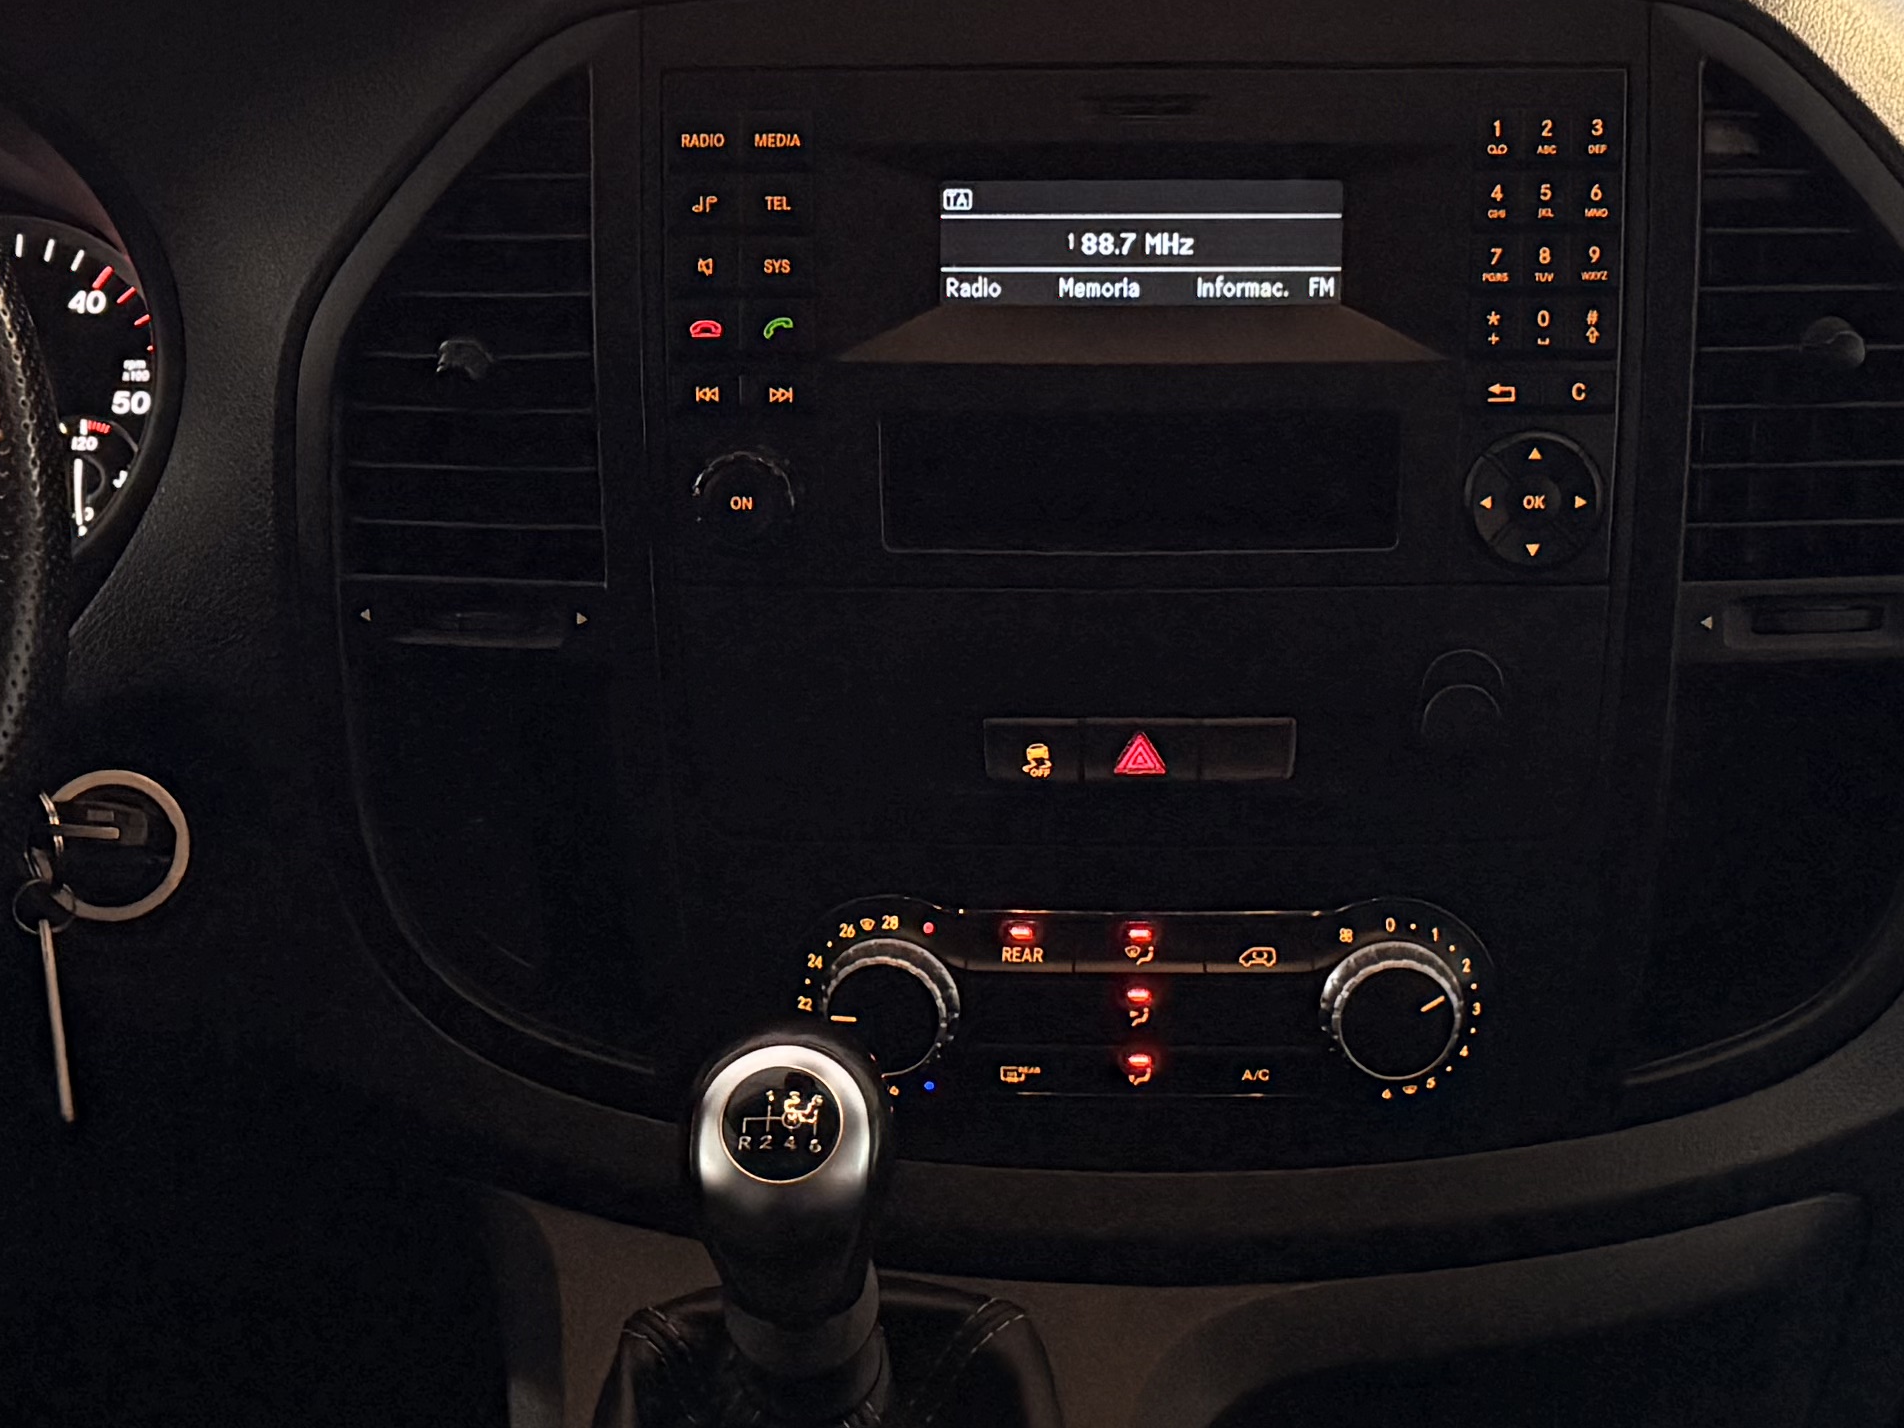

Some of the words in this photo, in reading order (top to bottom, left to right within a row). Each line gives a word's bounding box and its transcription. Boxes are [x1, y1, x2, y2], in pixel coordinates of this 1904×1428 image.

[1493, 119, 1501, 138] 1
[1541, 119, 1553, 137] 2
[1591, 118, 1604, 137] 3
[681, 133, 725, 148] RADIO
[754, 132, 801, 148] MEDIA
[1536, 144, 1557, 155] ABC
[946, 193, 969, 208] TA
[1490, 184, 1504, 202] 4
[1539, 183, 1552, 201] 5
[1590, 183, 1603, 201] 6
[764, 195, 792, 211] TEL
[1584, 207, 1609, 218] MNO
[1080, 232, 1137, 256] 88.7
[1144, 231, 1195, 256] MHz
[1490, 247, 1503, 266] 7
[1538, 246, 1552, 265] 8
[1588, 245, 1601, 263] 9
[763, 258, 791, 274] SYS
[1534, 272, 1554, 283] TUV
[1581, 270, 1608, 281] WXYZ
[945, 275, 1002, 299] Radio
[1058, 276, 1141, 299] Memoria
[1196, 274, 1290, 298] Informac.
[1308, 276, 1335, 298] FM
[68, 290, 106, 314] 40
[1537, 309, 1550, 328] 0
[123, 359, 149, 372] rpm
[1571, 382, 1586, 401] C
[111, 390, 152, 415] 50
[70, 435, 98, 451] 120
[730, 496, 753, 511] ON
[1522, 494, 1546, 510] OK
[1028, 764, 1053, 778] OFF
[838, 922, 857, 939] 26
[881, 914, 900, 931] 28
[1385, 917, 1397, 933] 0
[1431, 927, 1439, 942] 1
[807, 952, 823, 970] 24
[1001, 944, 1044, 964] REAR
[1461, 957, 1471, 974] 2
[797, 995, 813, 1012] 22
[1472, 1001, 1481, 1016] 3
[1241, 1068, 1270, 1082] A/C
[737, 1135, 752, 1151] R
[759, 1134, 773, 1150] 2
[784, 1135, 796, 1150] 4
